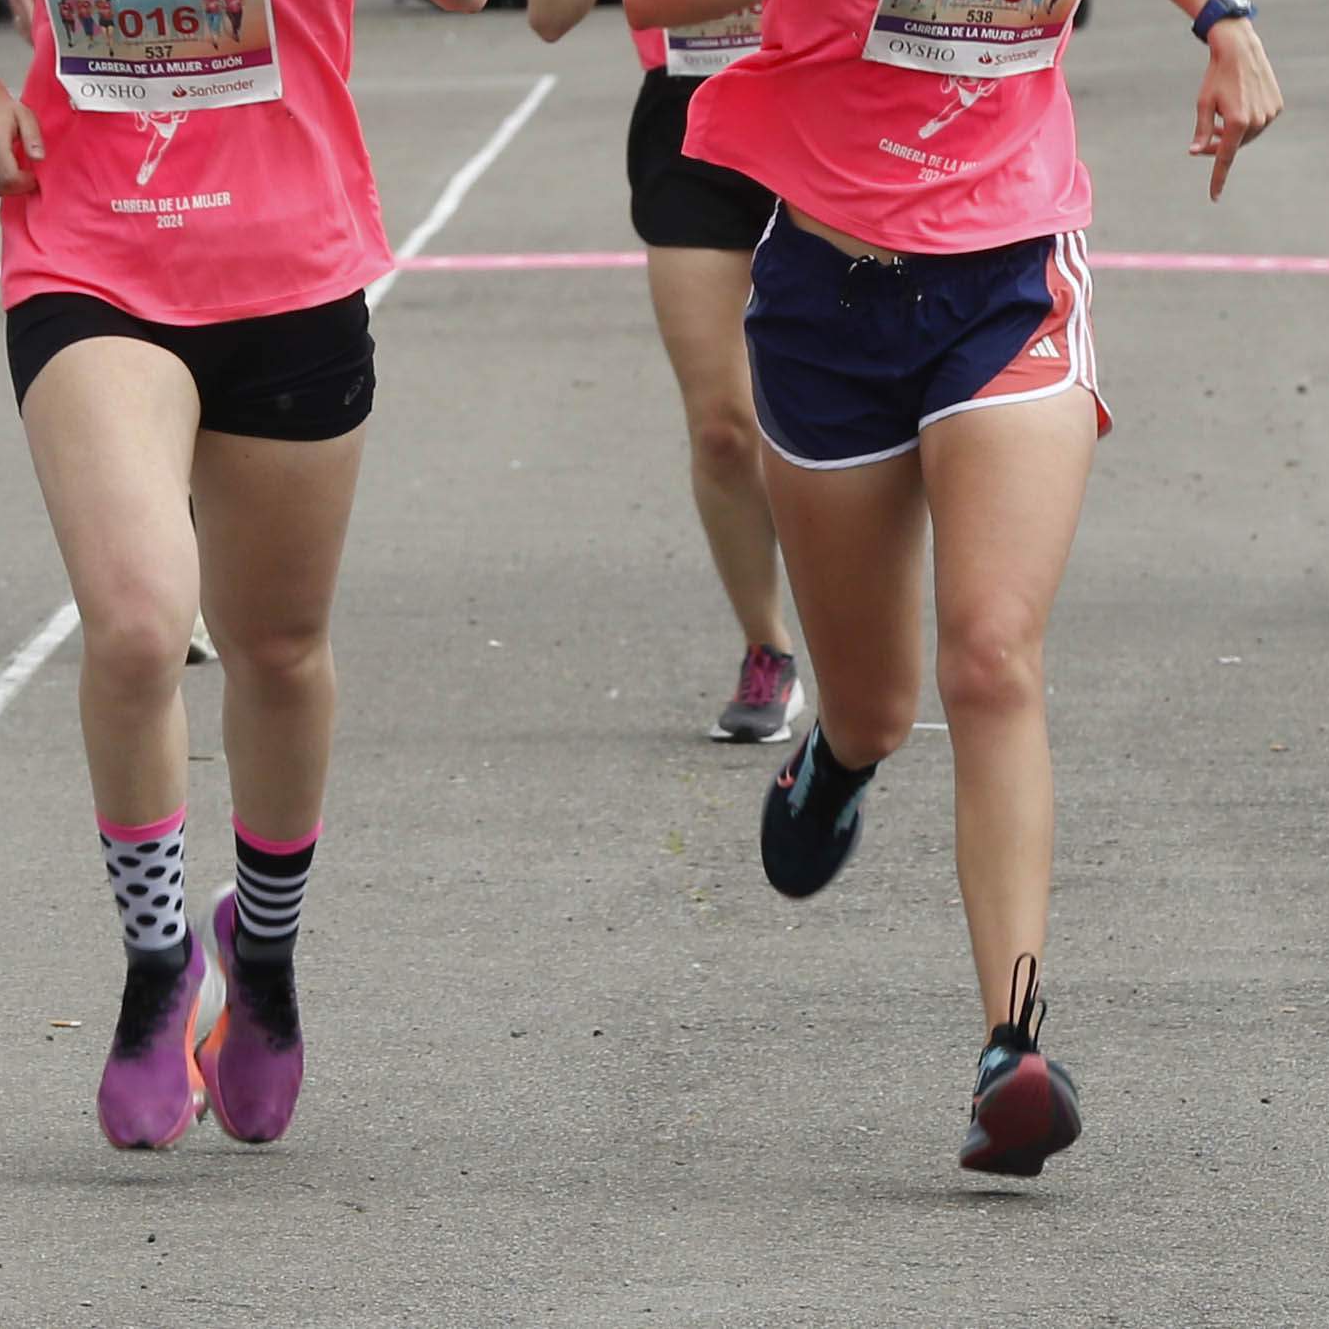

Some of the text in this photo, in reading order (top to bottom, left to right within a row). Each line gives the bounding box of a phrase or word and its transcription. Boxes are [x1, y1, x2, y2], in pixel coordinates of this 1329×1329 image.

[117, 6, 200, 38] 016
[966, 10, 993, 24] 538
[904, 21, 951, 38] CARRERA
[952, 27, 965, 37] DE
[967, 28, 979, 38] LA
[980, 28, 1015, 41] MUJER
[145, 45, 173, 60] 537
[888, 38, 956, 63] OYSHO
[88, 61, 131, 73] CARRERA
[134, 63, 147, 74] DE
[150, 63, 164, 74] LA
[167, 61, 202, 74] MUJER
[80, 82, 146, 99] OYSHO
[189, 78, 255, 98] Santander
[879, 138, 926, 164] CARRERA
[927, 154, 943, 166] DE
[944, 158, 957, 171] LA
[111, 192, 231, 213] CARRERA DE LA MUJER
[157, 214, 184, 229] 2024
